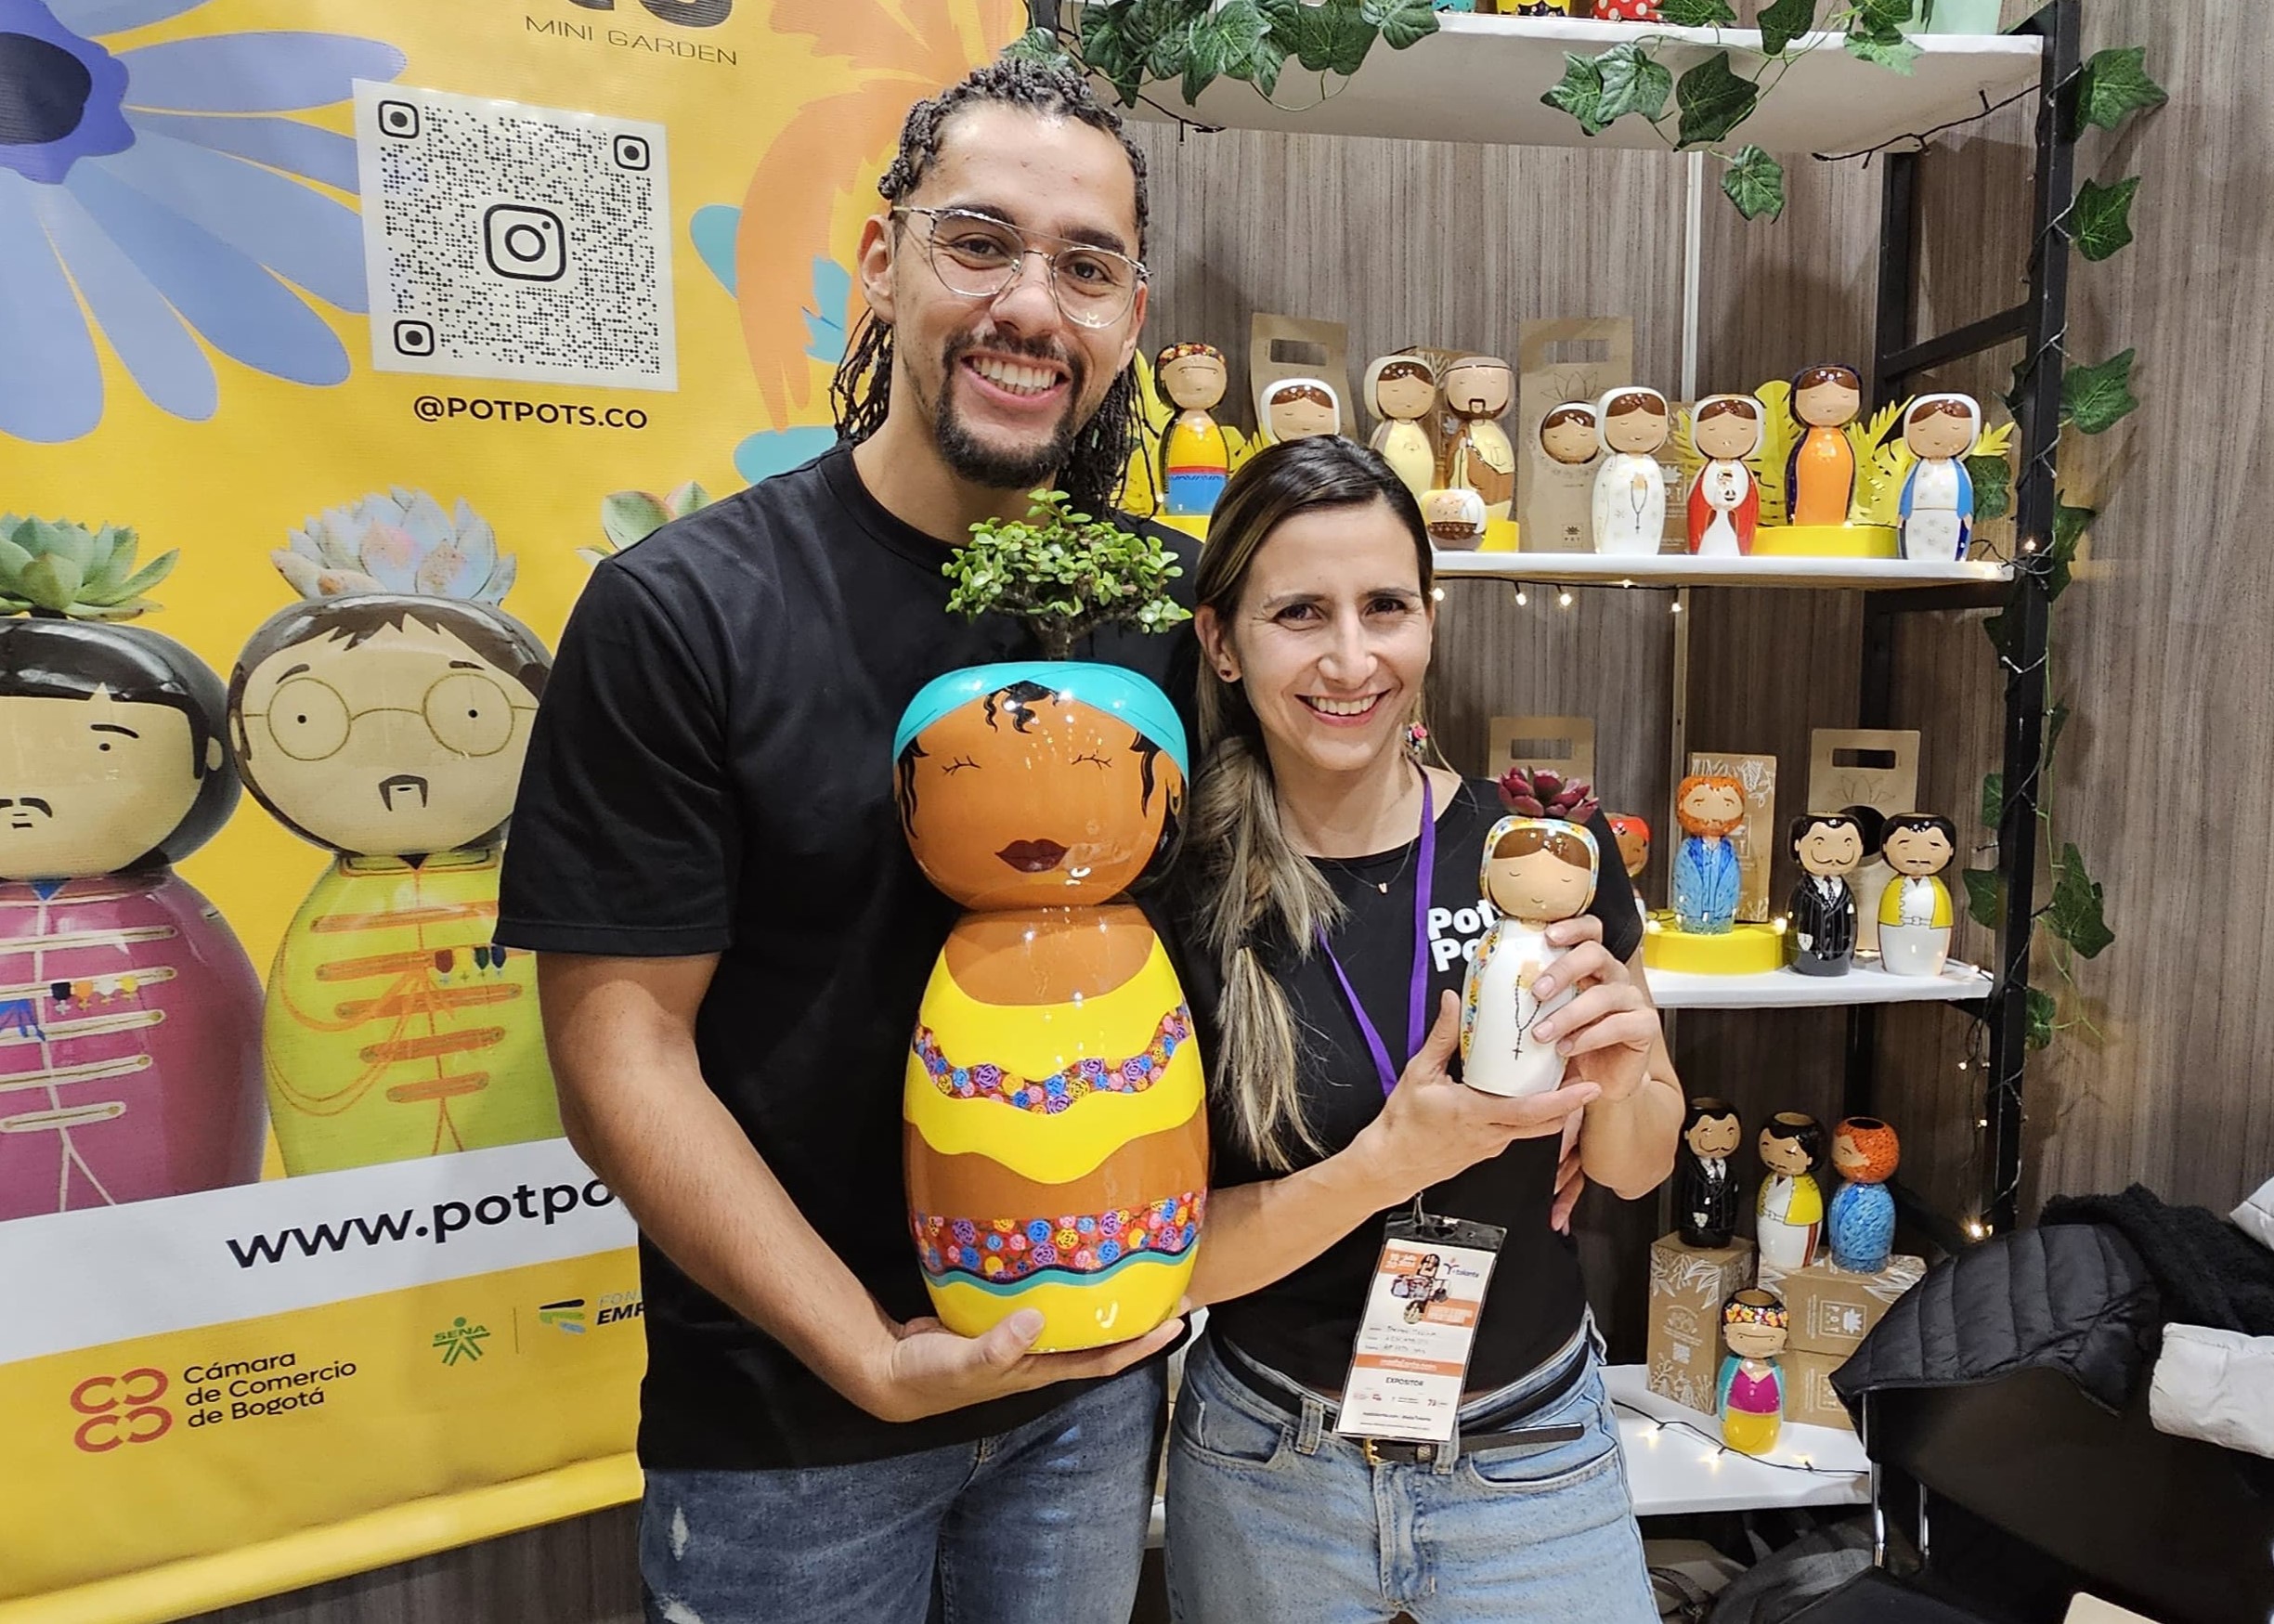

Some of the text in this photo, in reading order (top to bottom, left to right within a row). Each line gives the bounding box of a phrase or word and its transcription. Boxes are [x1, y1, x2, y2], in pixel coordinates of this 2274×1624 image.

[526, 16, 736, 65] MINI GARDEN
[414, 396, 648, 429] @POTPOTS.CO
[434, 1325, 488, 1341] SENA
[183, 1353, 296, 1384] Cámara
[185, 1361, 357, 1407] de Comercio
[1385, 1377, 1423, 1386] EXPOSITOR
[188, 1387, 325, 1428] de Bogotá
